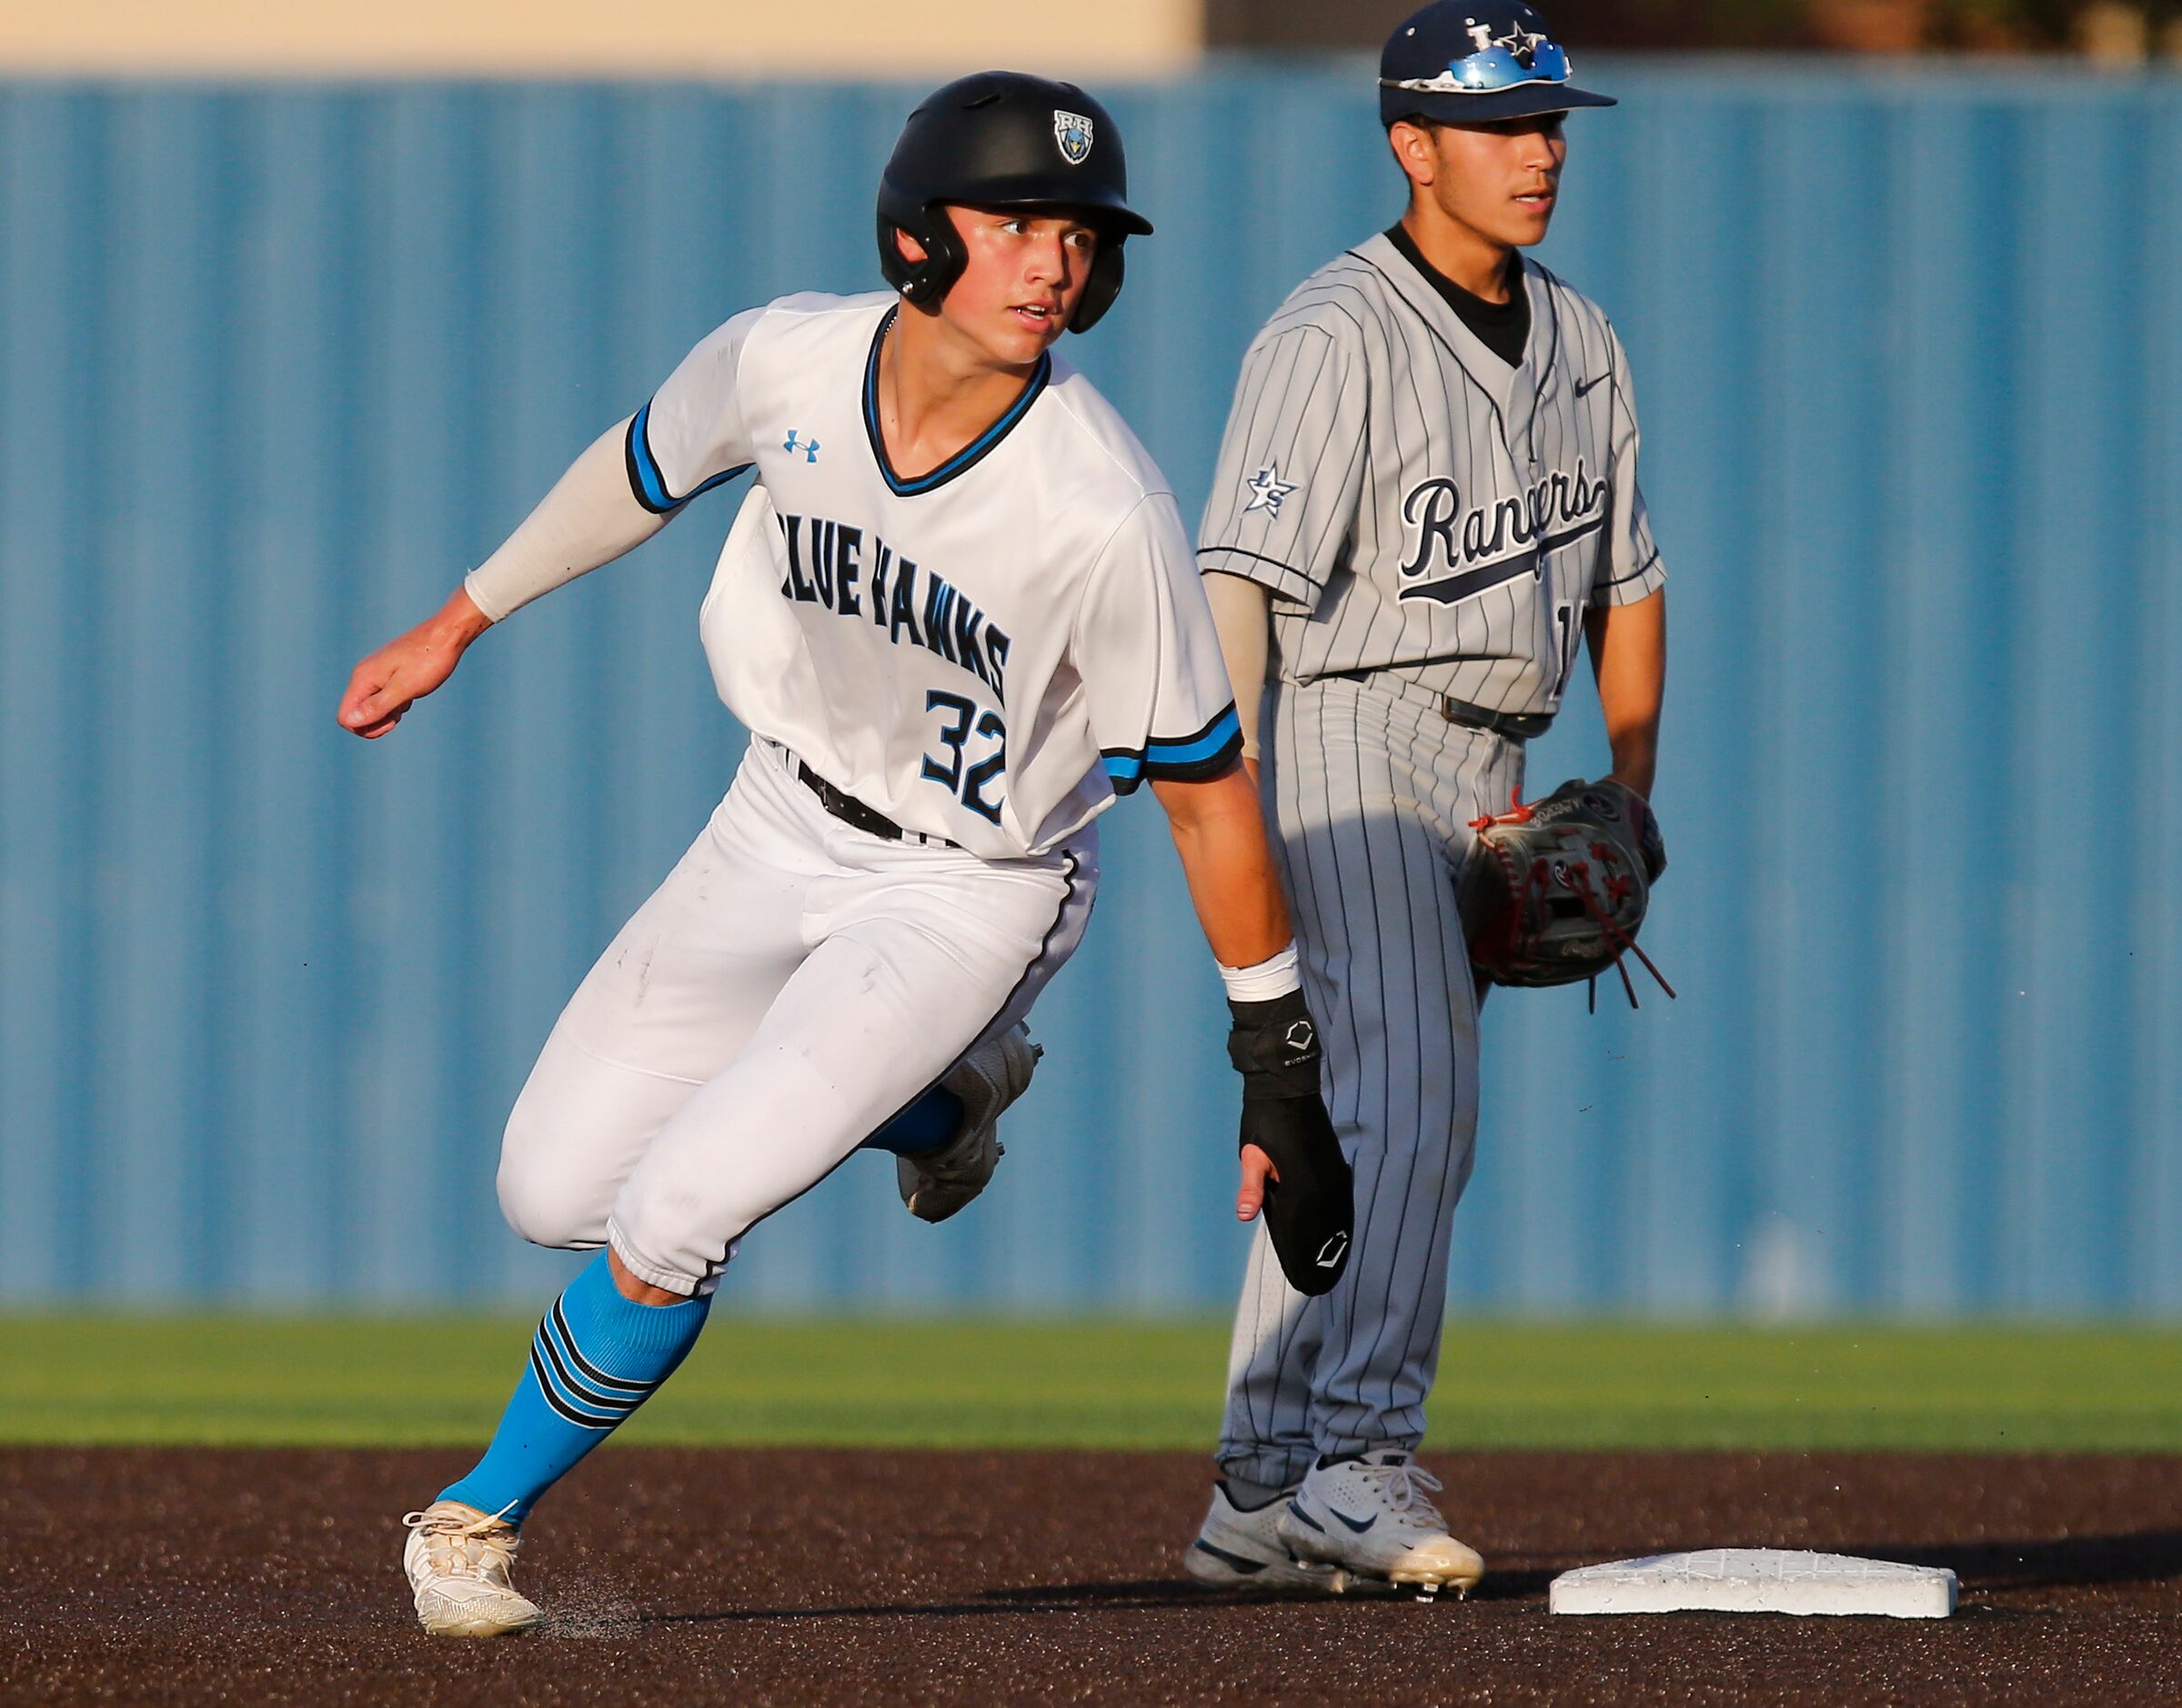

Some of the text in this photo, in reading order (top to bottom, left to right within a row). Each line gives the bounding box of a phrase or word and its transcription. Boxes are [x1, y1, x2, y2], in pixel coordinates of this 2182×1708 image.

[1057, 112, 1091, 138] RH
[776, 511, 1012, 710] LUE HAWKS
[1548, 598, 1588, 701] 1
[920, 688, 1007, 828] 32
